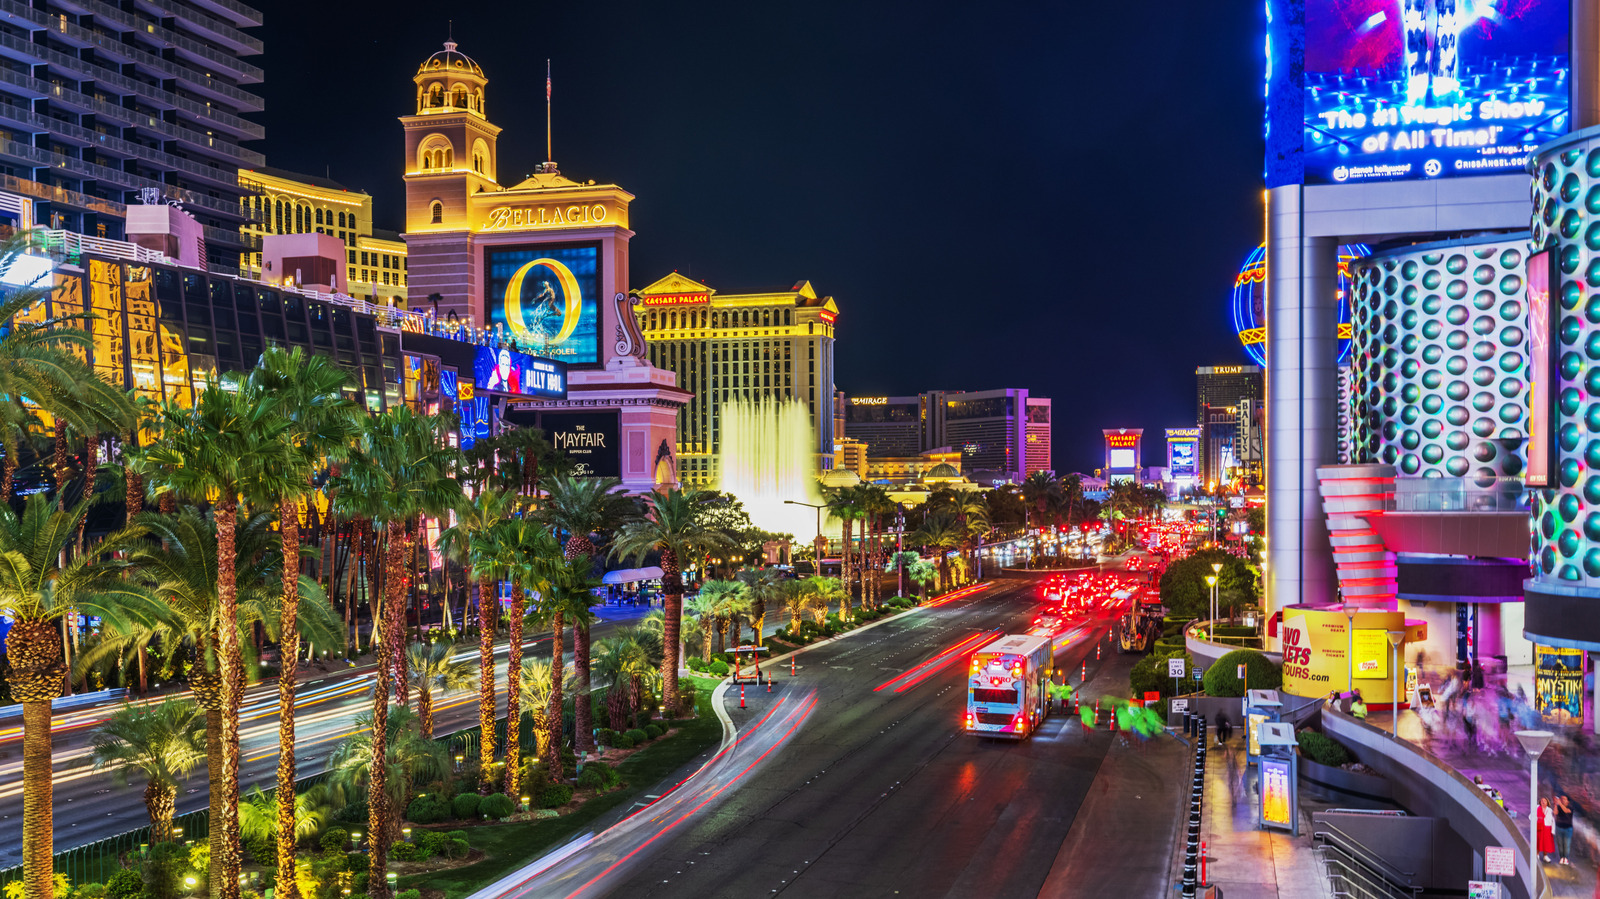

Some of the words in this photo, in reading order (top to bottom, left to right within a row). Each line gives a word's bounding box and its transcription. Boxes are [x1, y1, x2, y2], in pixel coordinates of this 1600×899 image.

[1373, 107, 1398, 127] #1
[1400, 104, 1473, 126] Magic
[1479, 100, 1545, 120] Show
[1362, 131, 1389, 152] of
[1393, 130, 1425, 150] All
[1481, 146, 1496, 155] Las
[482, 204, 607, 231] BELLAGIO
[645, 296, 677, 304] CAESARS
[679, 295, 707, 303] PALACE
[526, 369, 546, 389] BILLY
[1214, 366, 1242, 374] TRUMP
[859, 397, 887, 406] MIRAGE
[554, 431, 606, 449] MAYFAIR
